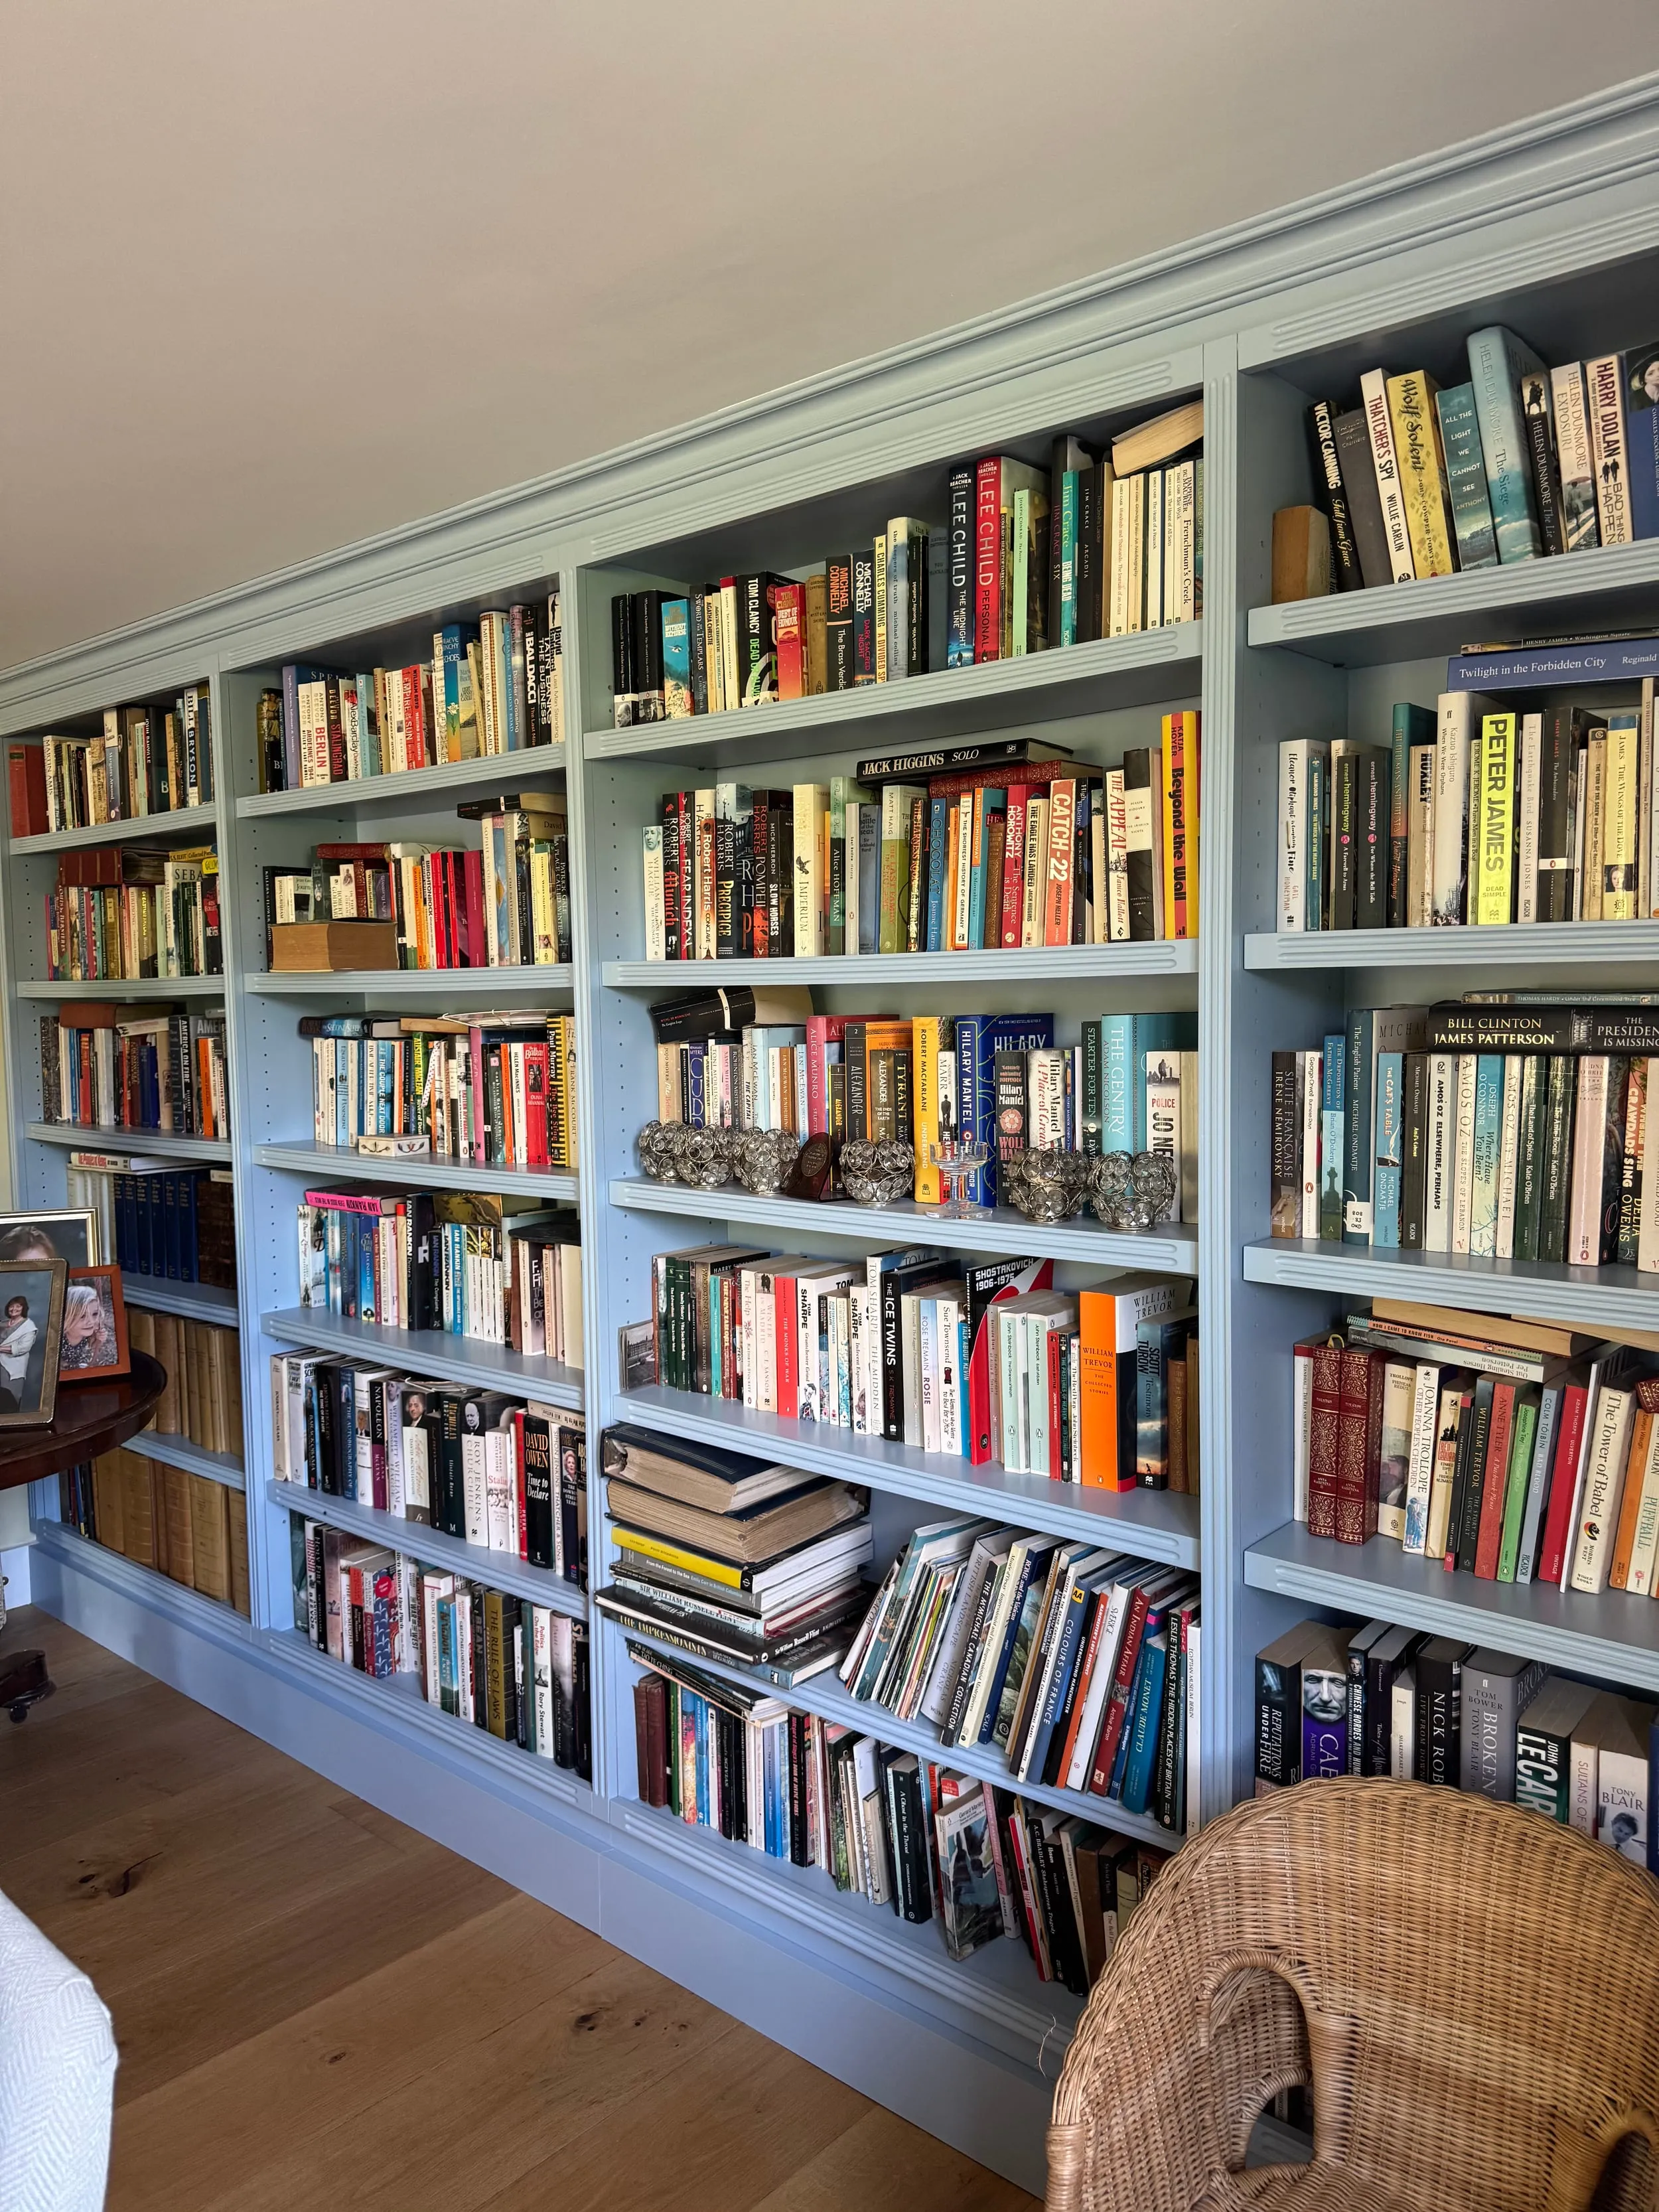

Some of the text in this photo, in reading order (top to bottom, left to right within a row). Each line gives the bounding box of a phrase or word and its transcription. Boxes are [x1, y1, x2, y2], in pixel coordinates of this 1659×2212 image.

[1400, 380, 1420, 418] Wolf
[1568, 371, 1587, 469] HELEN DUNMORE
[1597, 362, 1621, 458] HARRY DOLAN
[1315, 403, 1340, 489] VICTOR CANNING
[1369, 395, 1394, 482] THATCHER'S SPY
[1451, 429, 1471, 440] LIGHT
[1452, 463, 1480, 477] CANNOT
[1533, 421, 1551, 505] HELEN DUNMORE
[952, 492, 966, 587] LEE CHILD
[979, 479, 994, 586] LEE CHILD
[1390, 520, 1404, 552] CARLIN
[748, 578, 760, 634] TOM CLANCY
[830, 565, 840, 614] CONNELLY
[855, 561, 864, 613] CONNELLY
[981, 590, 991, 648] PERSONAL
[526, 638, 536, 703] BALDACCI
[1459, 656, 1607, 678] Twilight the Forbidden City
[1623, 654, 1656, 664] Reginald
[315, 727, 326, 768] BERLIN
[330, 723, 343, 775] STALINGRAD
[863, 749, 979, 776] JACK HIGGINS SOLO
[1169, 767, 1185, 829] Beyond
[1420, 753, 1433, 803] HUXLEY
[1485, 720, 1508, 871] PETER JAMES
[1111, 796, 1126, 853] APPEAL
[1342, 782, 1351, 833] hemingway
[1368, 781, 1378, 831] hemingway
[670, 818, 679, 865] ROBERT
[702, 835, 712, 873] Robert
[725, 824, 733, 871] ROBERT
[1006, 806, 1015, 859] HOROWITZ
[1014, 806, 1023, 857] ANTHONY
[1050, 794, 1071, 882] CATCH-22
[1173, 834, 1185, 860] the
[930, 819, 942, 895] CHOCOLAT
[664, 870, 680, 926] Munich
[681, 859, 693, 935] FEAR INDEX
[756, 857, 766, 907] POMPEII
[718, 880, 733, 937] PRECIPICE
[770, 883, 779, 936] SLOW HORSES
[799, 881, 808, 932] IMPERIUM
[1435, 1033, 1554, 1045] JAMES PATTERSON
[1447, 1019, 1542, 1029] BILL CLINTON
[1597, 1026, 1659, 1036] PRESIDEN
[1603, 1038, 1613, 1047] IS
[850, 1066, 863, 1115] ALEXANDER
[897, 1065, 907, 1120] TYRANT
[962, 1031, 972, 1124] HILARY MANTEL
[1000, 1085, 1023, 1097] Hilary
[1050, 1059, 1060, 1133] Hilary Mantel
[1108, 1027, 1125, 1136] THE GENTRY
[1477, 1074, 1486, 1126] O'CONNOR
[1152, 1098, 1175, 1108] POLICE
[1153, 1112, 1174, 1132] JO
[1283, 1071, 1293, 1178] SUITE FRANÇAISE
[1623, 1151, 1632, 1187] SING
[1620, 1194, 1632, 1242] OWENS
[975, 1258, 1034, 1281] SHOSTAKOVICH
[976, 1274, 1015, 1291] 1906-1975
[1133, 1290, 1175, 1307] WILLIAM
[1136, 1301, 1172, 1319] TREVOR
[885, 1298, 895, 1366] ICE TWINS
[1082, 1347, 1113, 1358] WILLIAM
[1084, 1359, 1112, 1368] TREVOR
[1137, 1341, 1149, 1374] TUROW
[1144, 1378, 1153, 1419] Testimony
[526, 1432, 548, 1450] DAVID
[526, 1449, 548, 1468] OWEN
[1418, 1384, 1435, 1493] JOANNA TROLLOPE
[1472, 1407, 1487, 1488] WILLIAM TREVOR
[1590, 1393, 1622, 1518] The Tower Babel
[527, 1473, 541, 1486] Time
[527, 1483, 548, 1501] Declare
[637, 1620, 707, 1657] IMPRESSIONISTS
[794, 1633, 809, 1647] Russell
[961, 1642, 976, 1683] CANADIAN
[1119, 1611, 1141, 1677] INDIAN AFFAIR
[492, 1668, 499, 1684] OF
[1045, 1619, 1074, 1724] COLOURS FRANCE
[1475, 1689, 1496, 1700] TOM
[948, 1685, 964, 1731] COLLECTION
[1136, 1678, 1152, 1753] CLAUDE MONET
[1433, 1692, 1444, 1737] NICK
[1469, 1696, 1503, 1710] BOWER
[1260, 1739, 1271, 1773] FIRE
[1271, 1708, 1283, 1779] REPUTATIONS
[1482, 1711, 1497, 1793] BROKEN
[1547, 1740, 1558, 1764] JOHN
[1603, 1793, 1644, 1810] BLAIR
[1611, 1787, 1636, 1798] TONY
